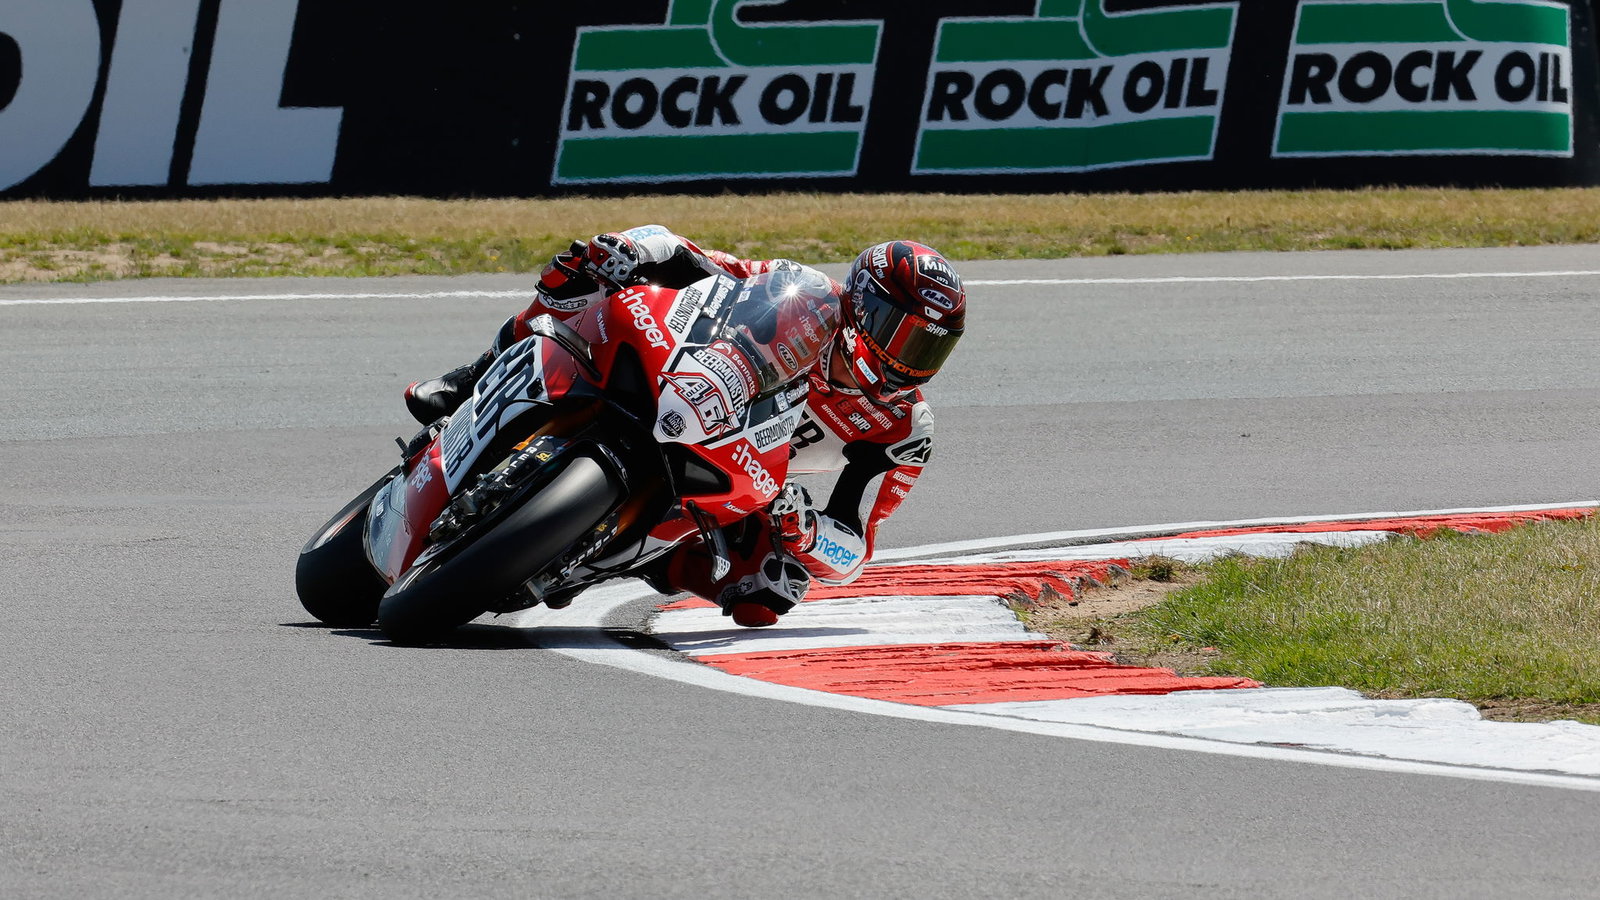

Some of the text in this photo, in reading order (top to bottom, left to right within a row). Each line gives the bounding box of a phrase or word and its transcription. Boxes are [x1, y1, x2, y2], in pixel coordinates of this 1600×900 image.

[926, 57, 1218, 121] ROCK OIL
[1287, 50, 1568, 105] ROCK OIL
[566, 73, 864, 131] ROCK OIL
[668, 286, 703, 334] BEERMONSTER
[923, 290, 952, 308] HJC
[685, 381, 706, 398] OLLIE
[693, 349, 746, 418] BEERMONSTER
[731, 353, 756, 396] Bennetts
[754, 415, 796, 448] BEERMONSTER
[821, 404, 853, 437] BRIDEWELL
[857, 396, 893, 430] BEERMONSTER
